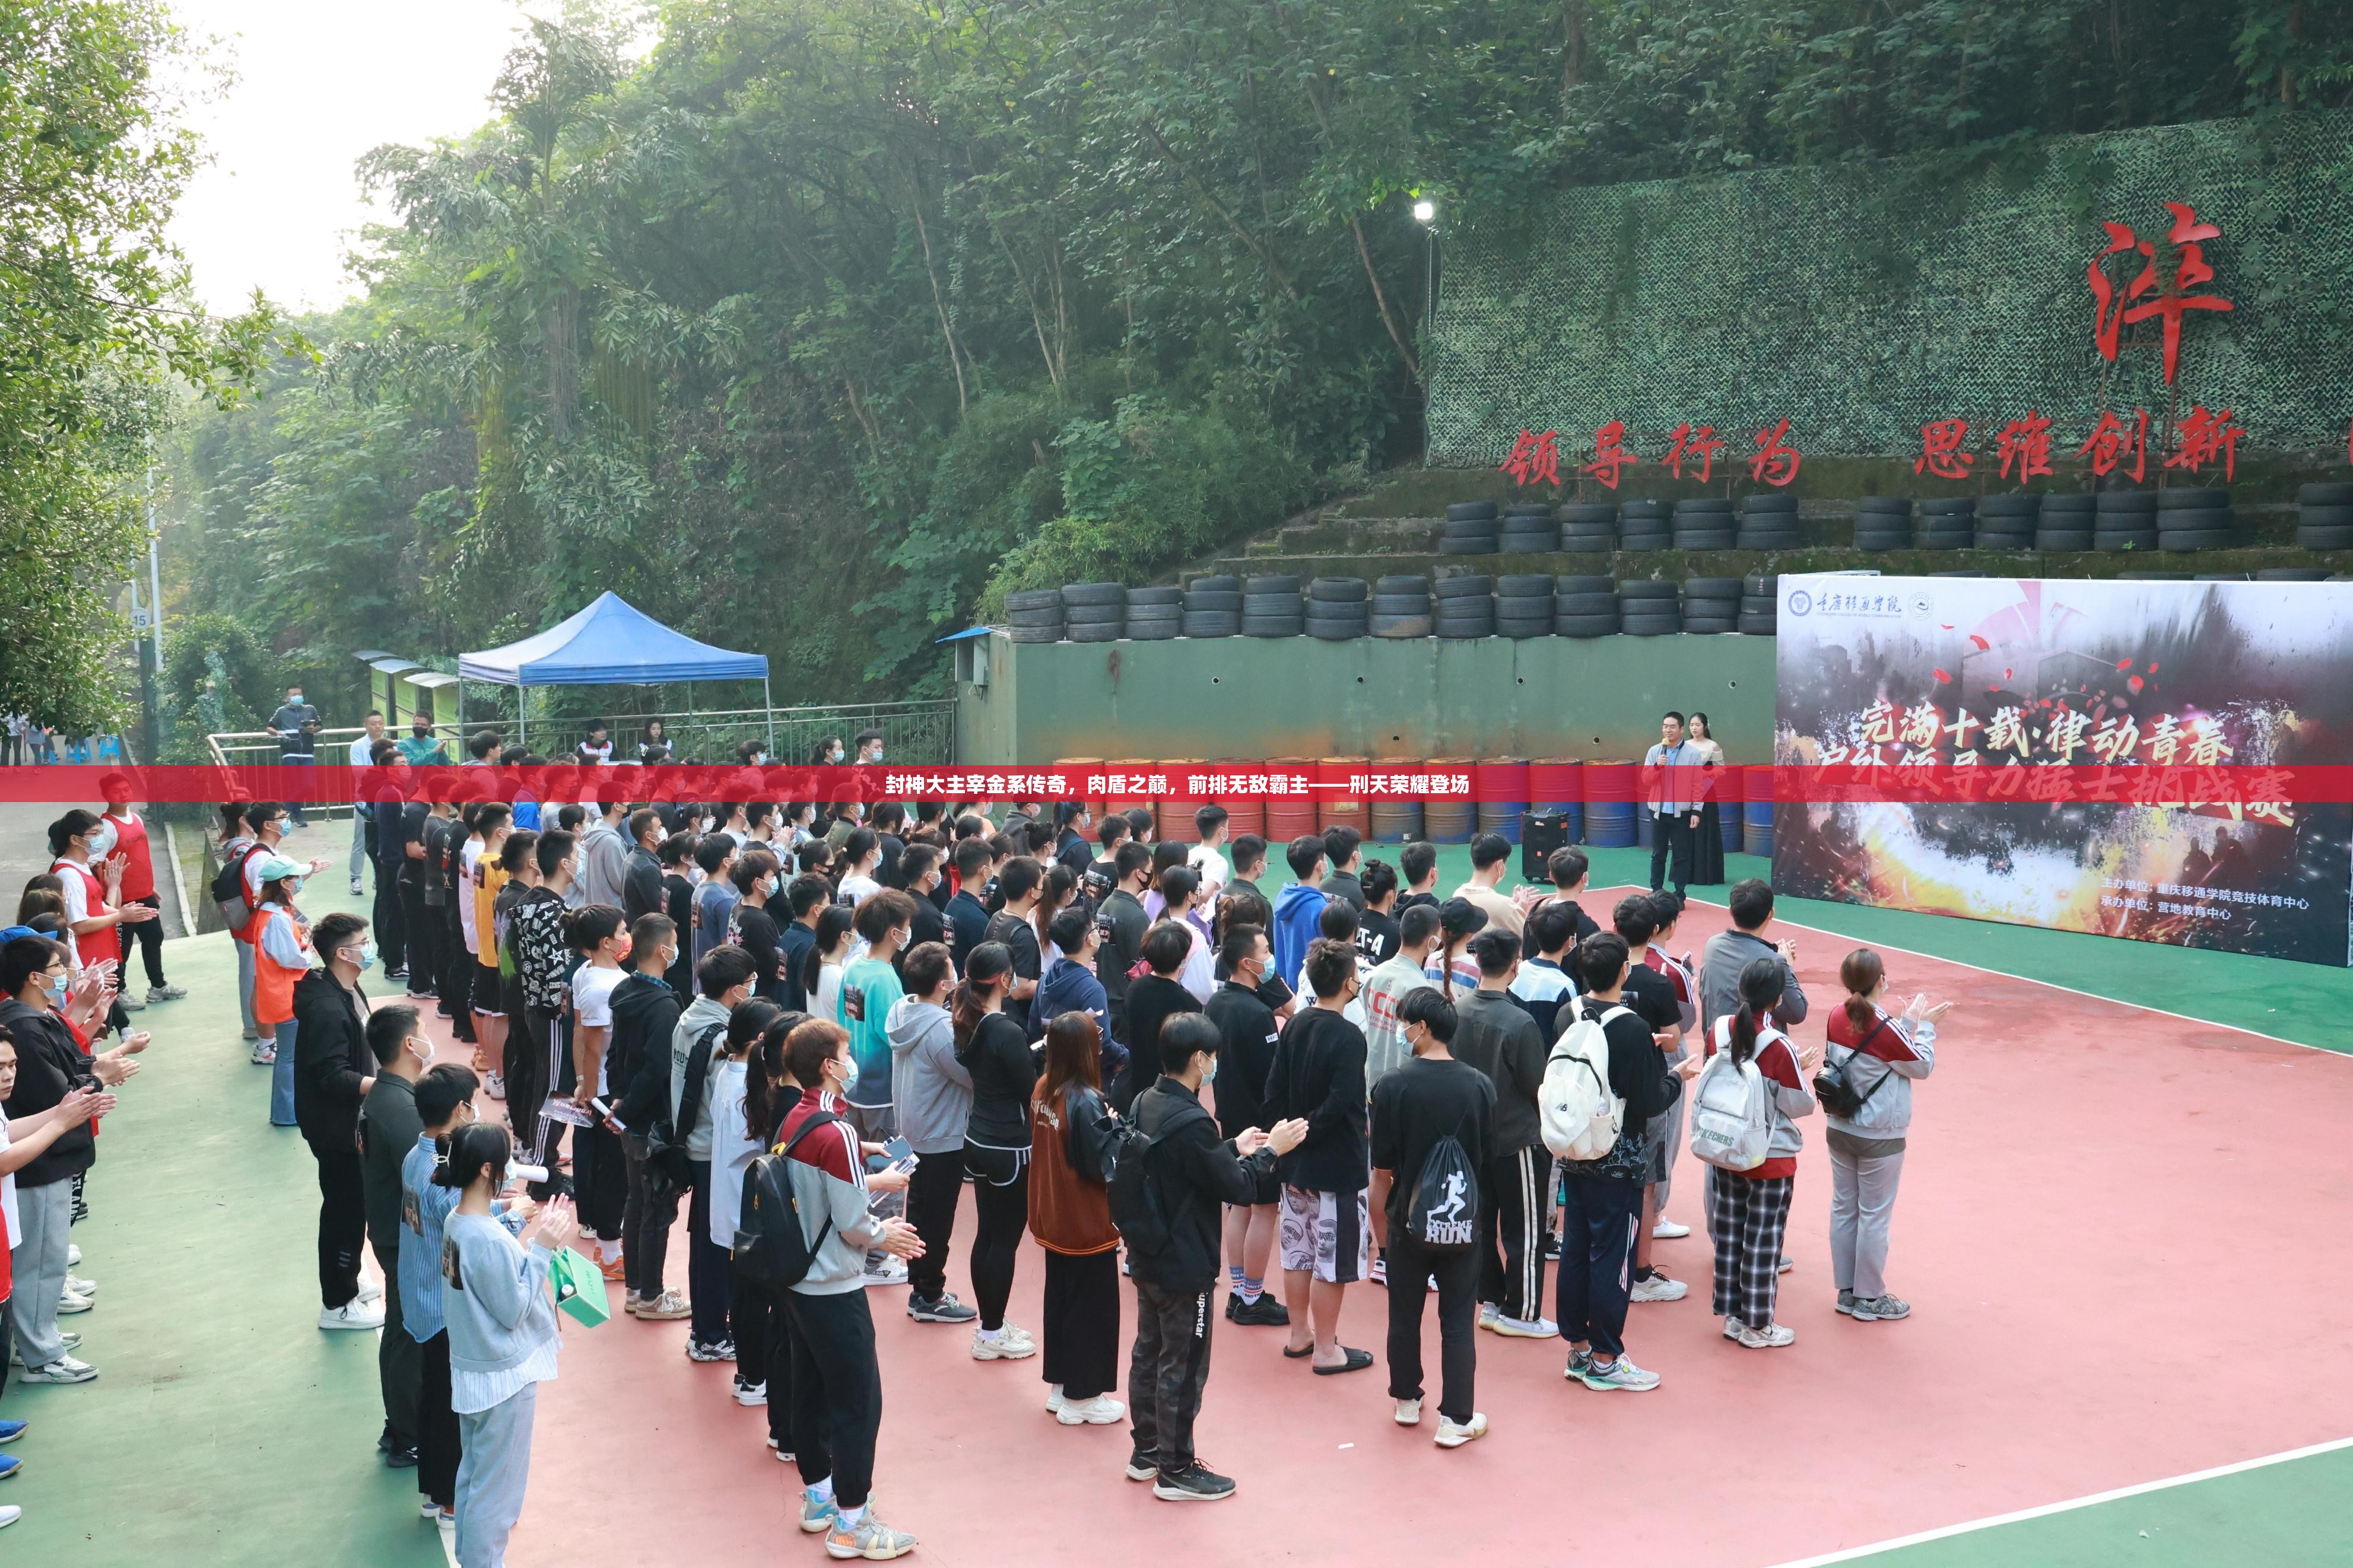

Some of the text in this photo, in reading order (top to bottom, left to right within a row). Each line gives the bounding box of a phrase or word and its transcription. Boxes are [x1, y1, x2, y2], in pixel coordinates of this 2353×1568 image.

[1500, 416, 1801, 490] 领导行为
[1914, 406, 2247, 485] 思维创新
[132, 615, 146, 626] 15
[1701, 1127, 1735, 1147] KECHERS
[1427, 1219, 1472, 1230] EXTREME
[1424, 1227, 1472, 1244] RUN
[1195, 1292, 1206, 1338] uperstar
